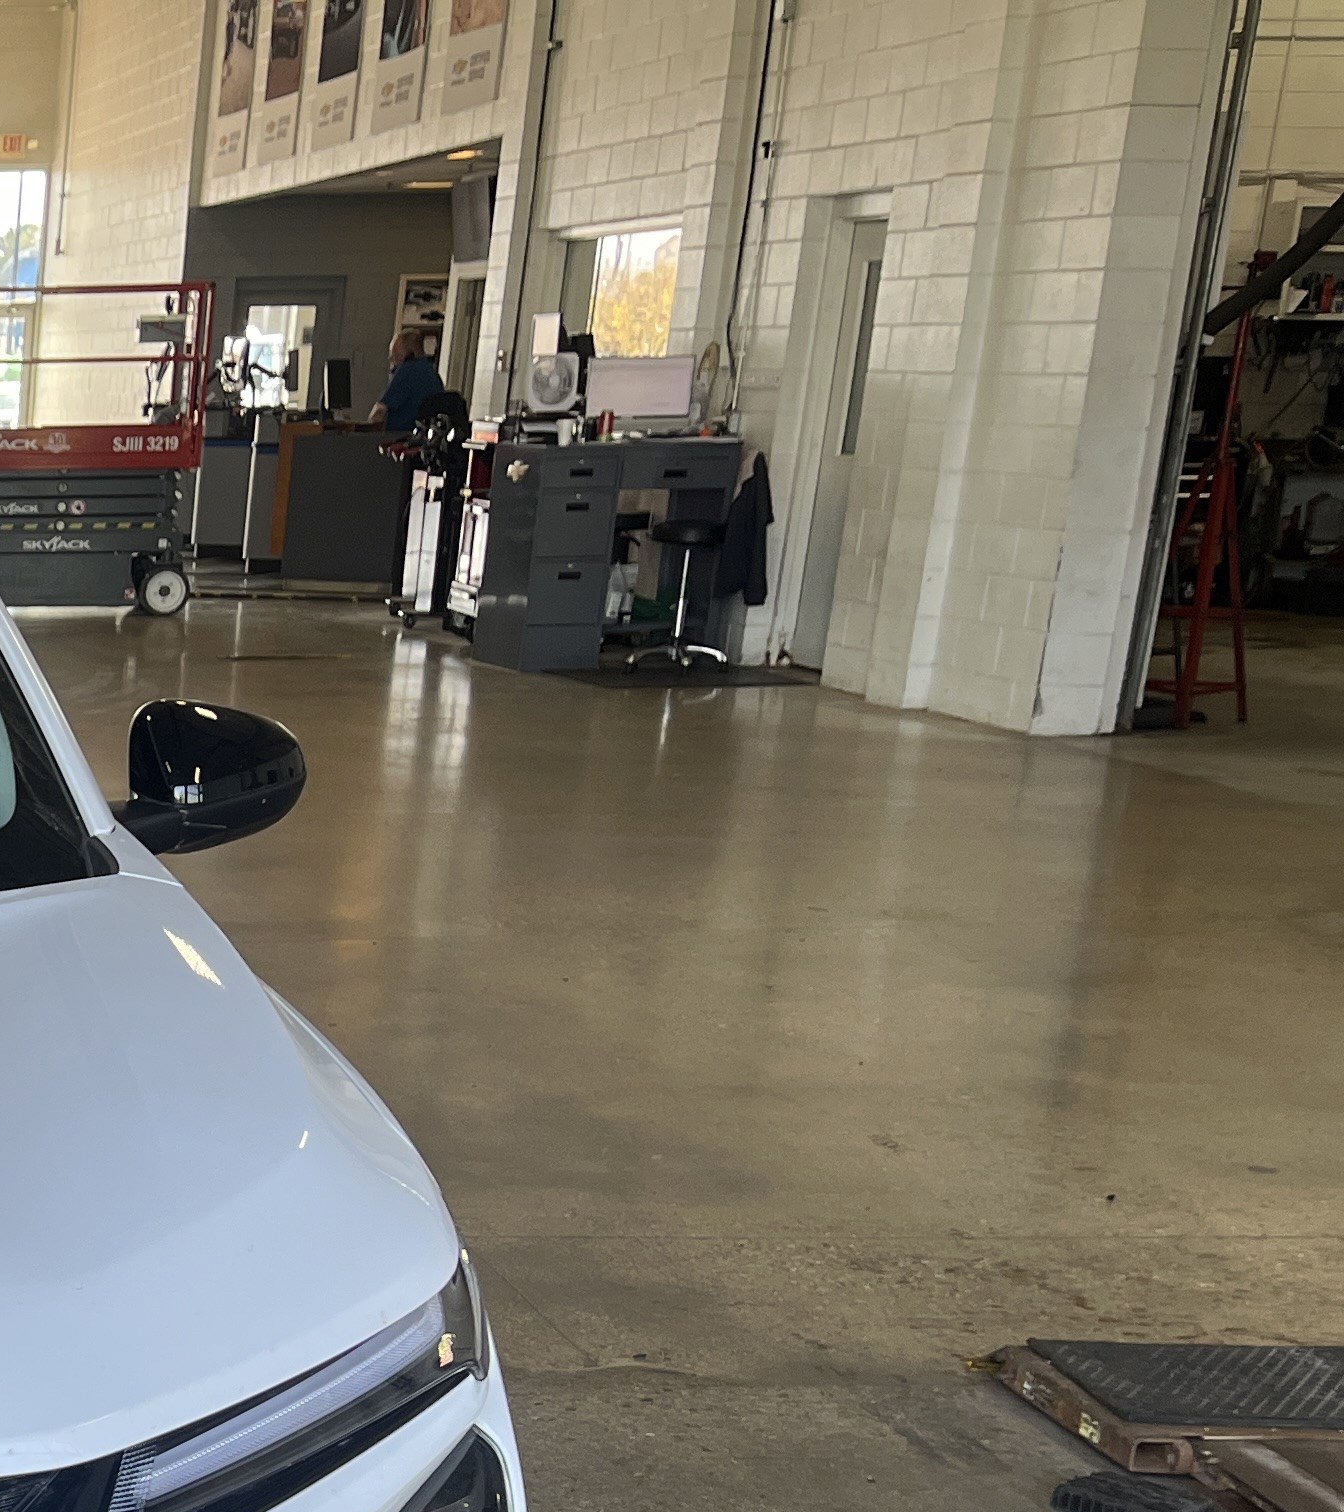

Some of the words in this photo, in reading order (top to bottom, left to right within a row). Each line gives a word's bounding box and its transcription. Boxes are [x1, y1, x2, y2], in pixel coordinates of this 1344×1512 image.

[112, 436, 144, 452] SJIII
[146, 435, 180, 451] 3219
[22, 536, 91, 551] SKYJACK
